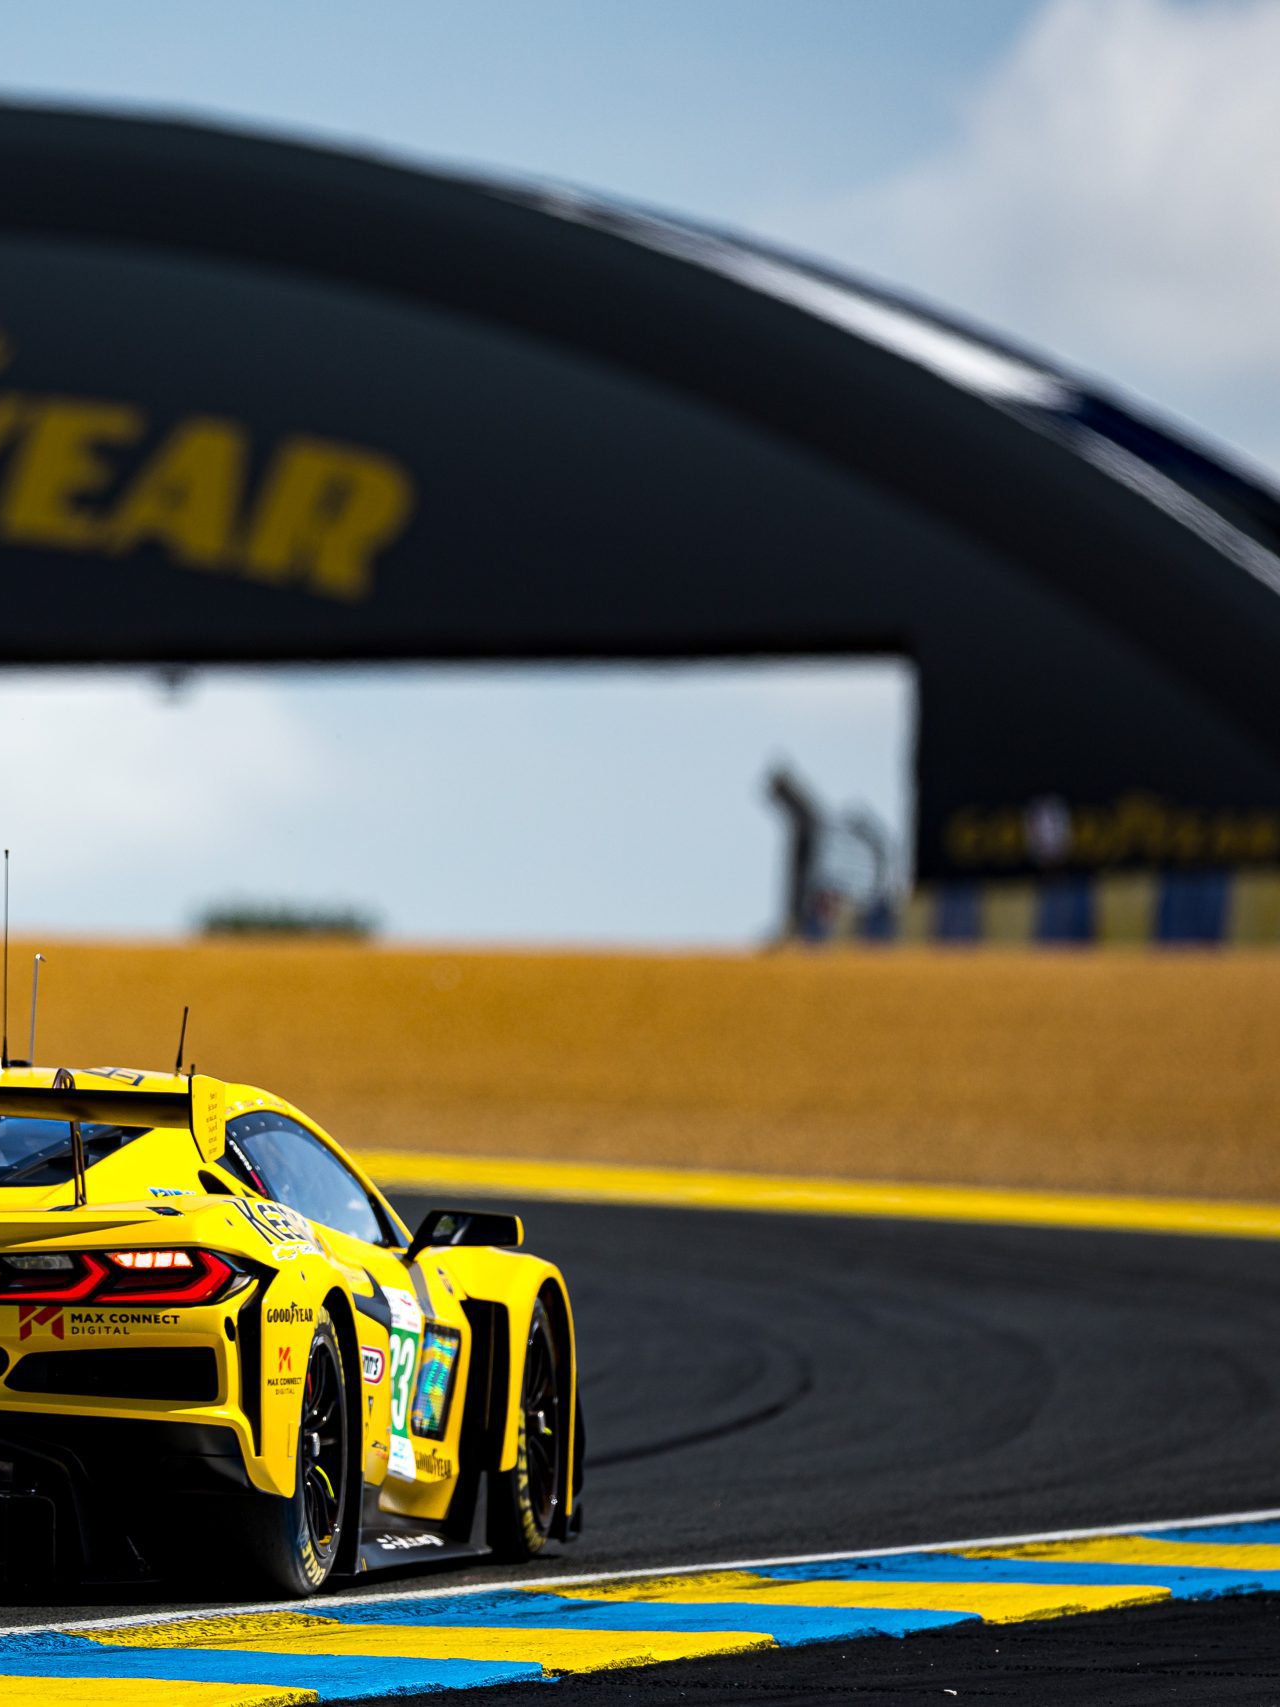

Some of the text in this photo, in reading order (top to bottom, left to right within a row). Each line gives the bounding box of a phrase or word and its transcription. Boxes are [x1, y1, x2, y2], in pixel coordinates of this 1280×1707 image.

[70, 1312, 181, 1325] MAX CONNECT
[266, 1301, 314, 1325] GOODYEAR
[71, 1325, 130, 1336] DIGITAL
